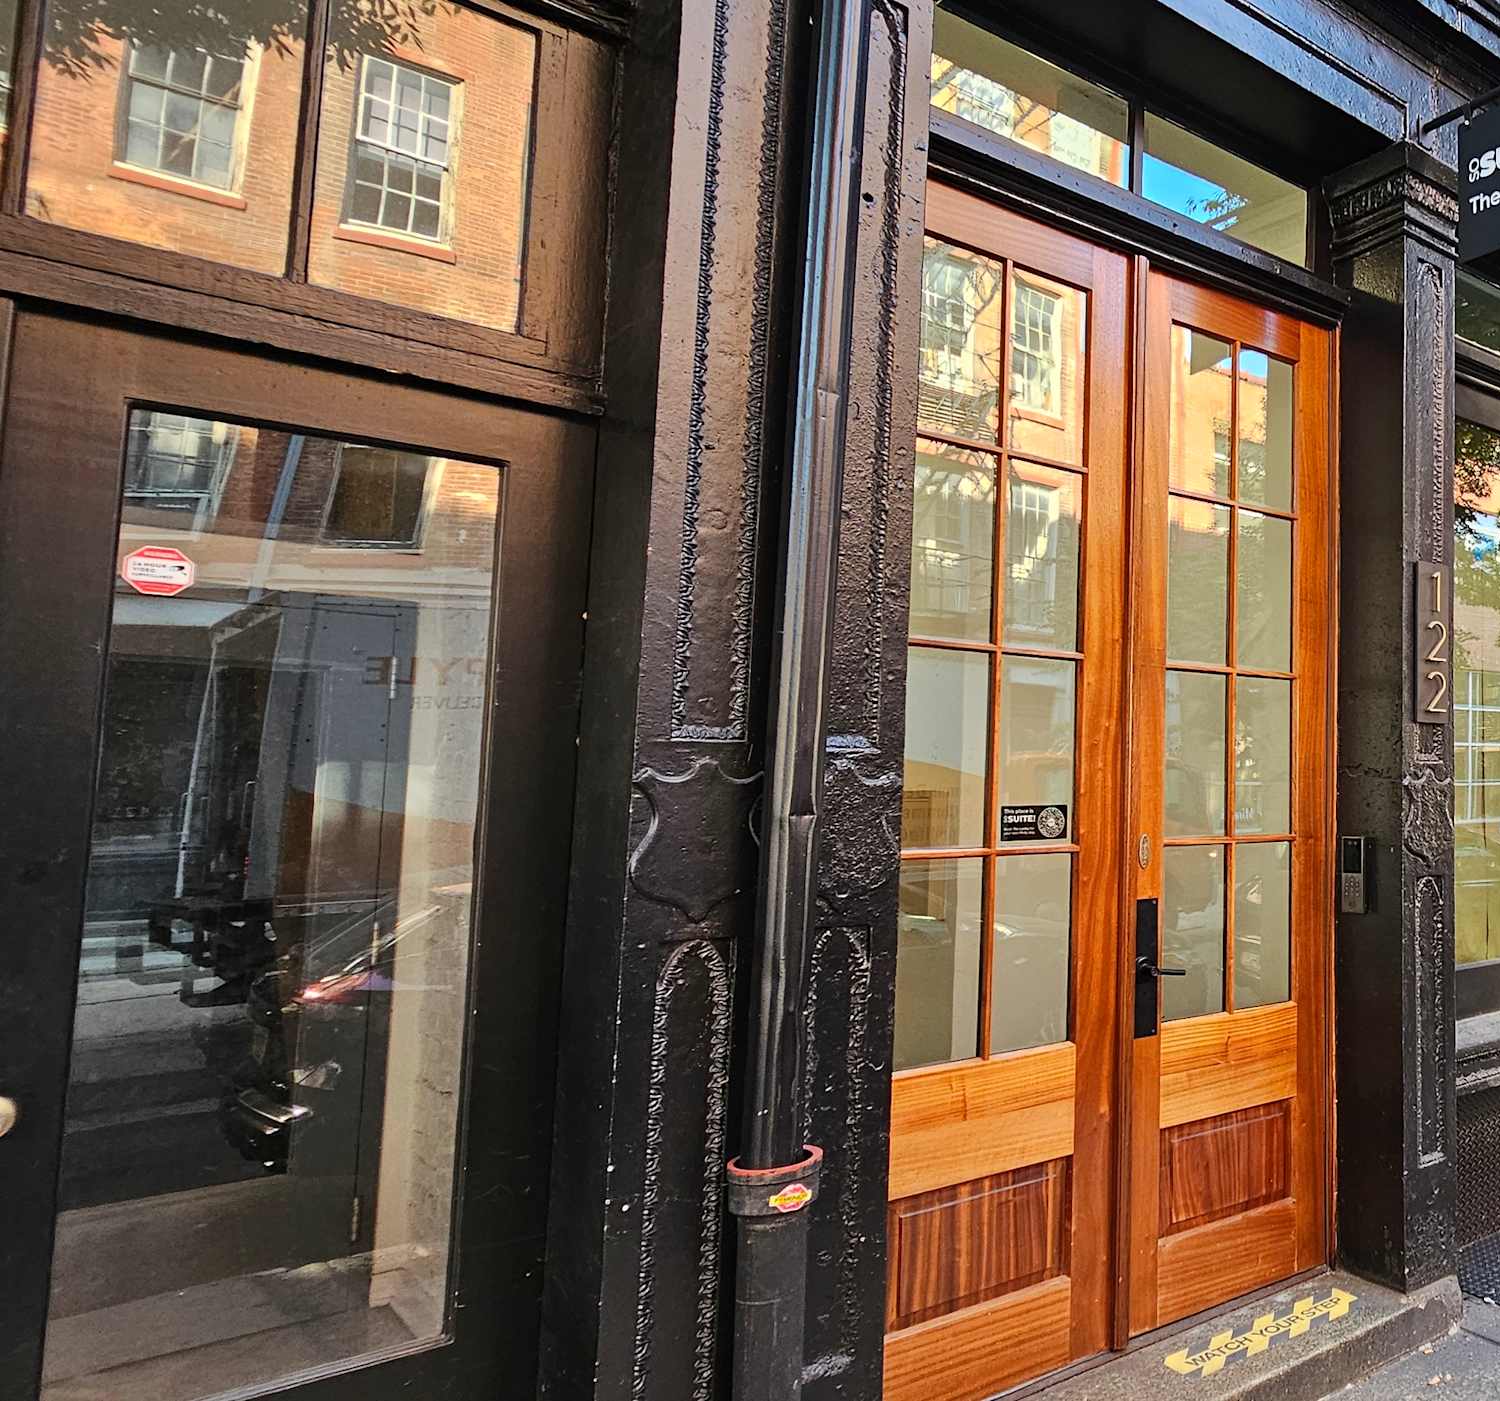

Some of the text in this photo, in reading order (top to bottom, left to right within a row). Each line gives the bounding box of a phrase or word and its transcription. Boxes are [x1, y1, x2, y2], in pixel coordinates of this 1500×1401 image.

[1425, 571, 1448, 714] 122
[1186, 1296, 1341, 1368] WATCH YOUR STEP
